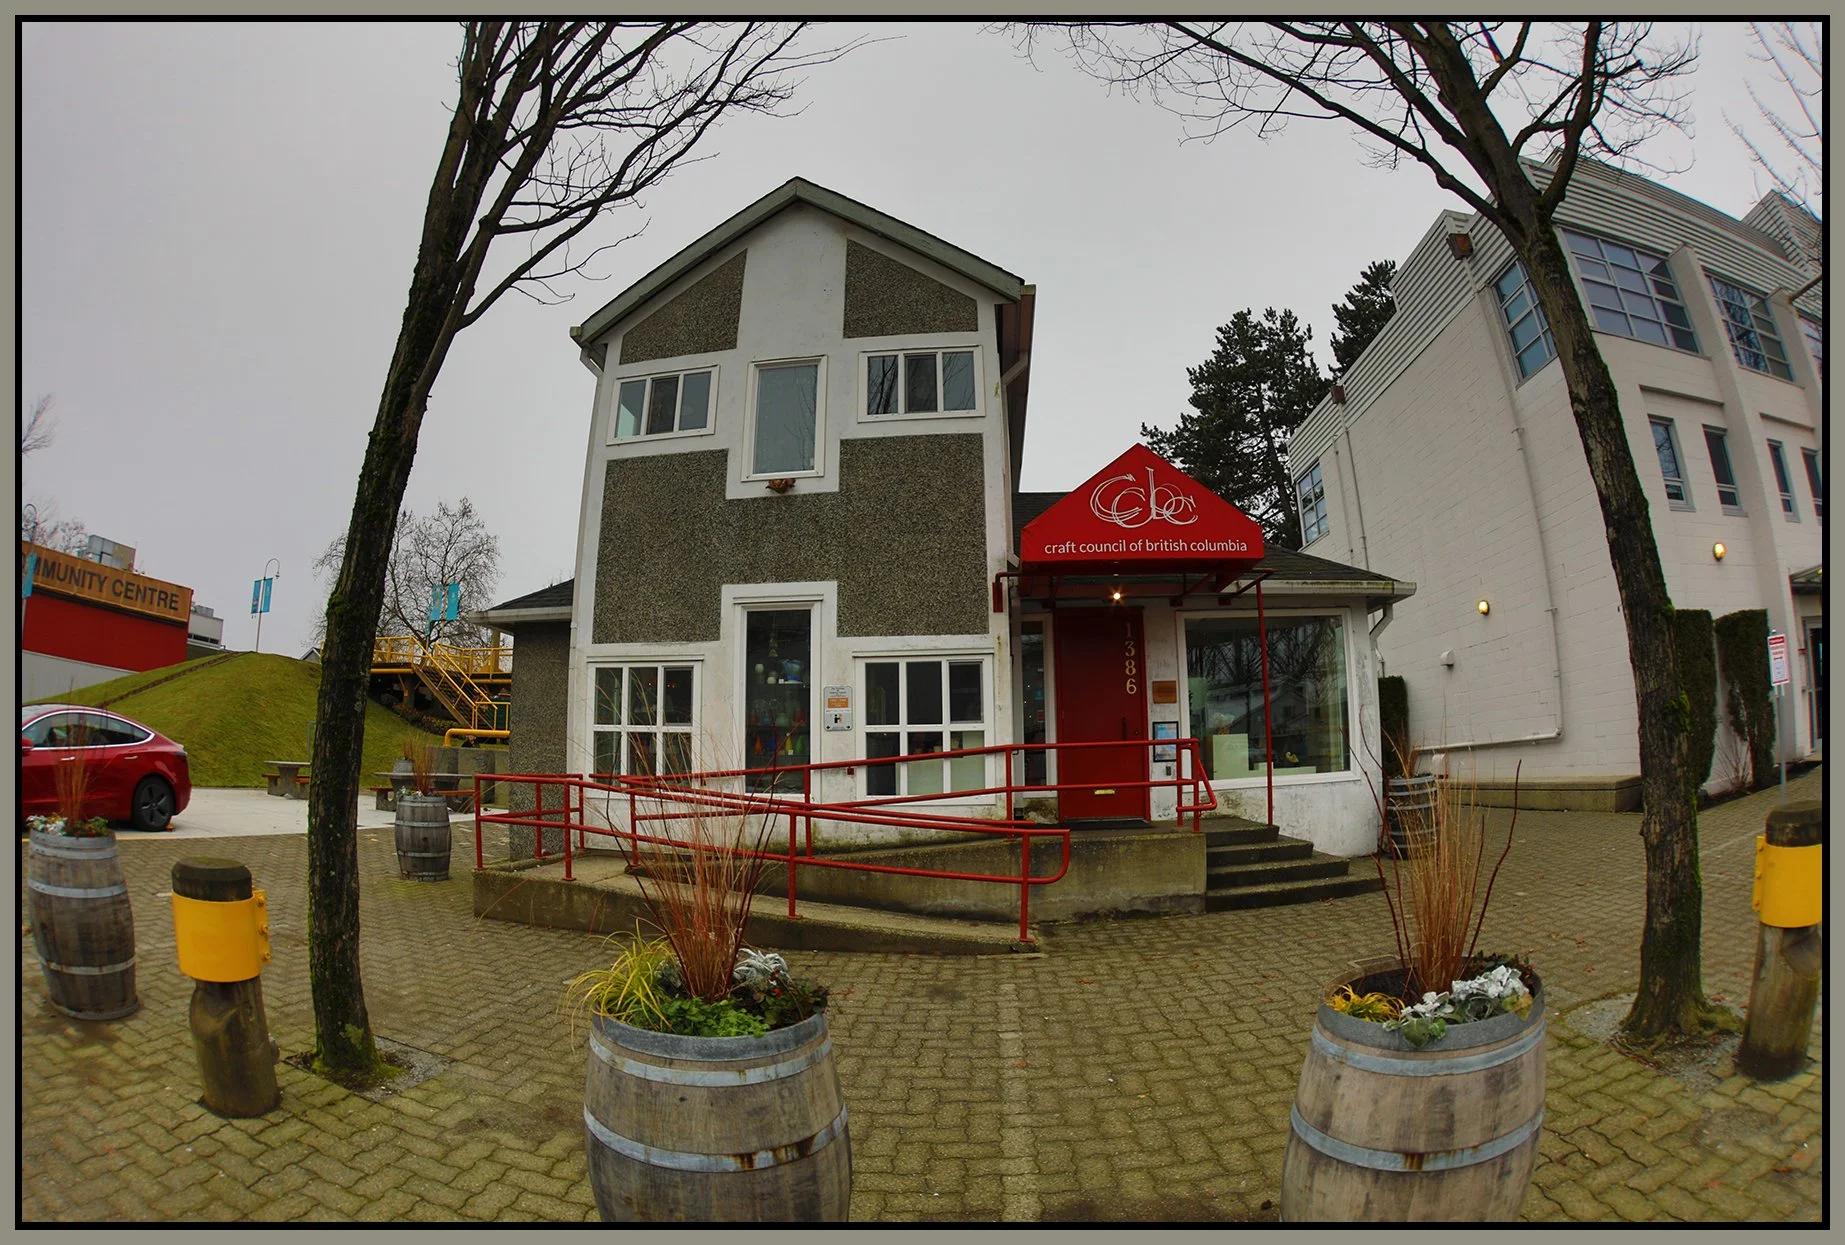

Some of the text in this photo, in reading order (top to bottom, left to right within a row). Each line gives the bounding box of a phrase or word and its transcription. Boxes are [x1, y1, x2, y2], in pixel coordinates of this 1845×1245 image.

[1044, 538, 1248, 554] craft council of british columbia
[111, 578, 180, 611] CENTRE
[1124, 621, 1138, 695] 1386
